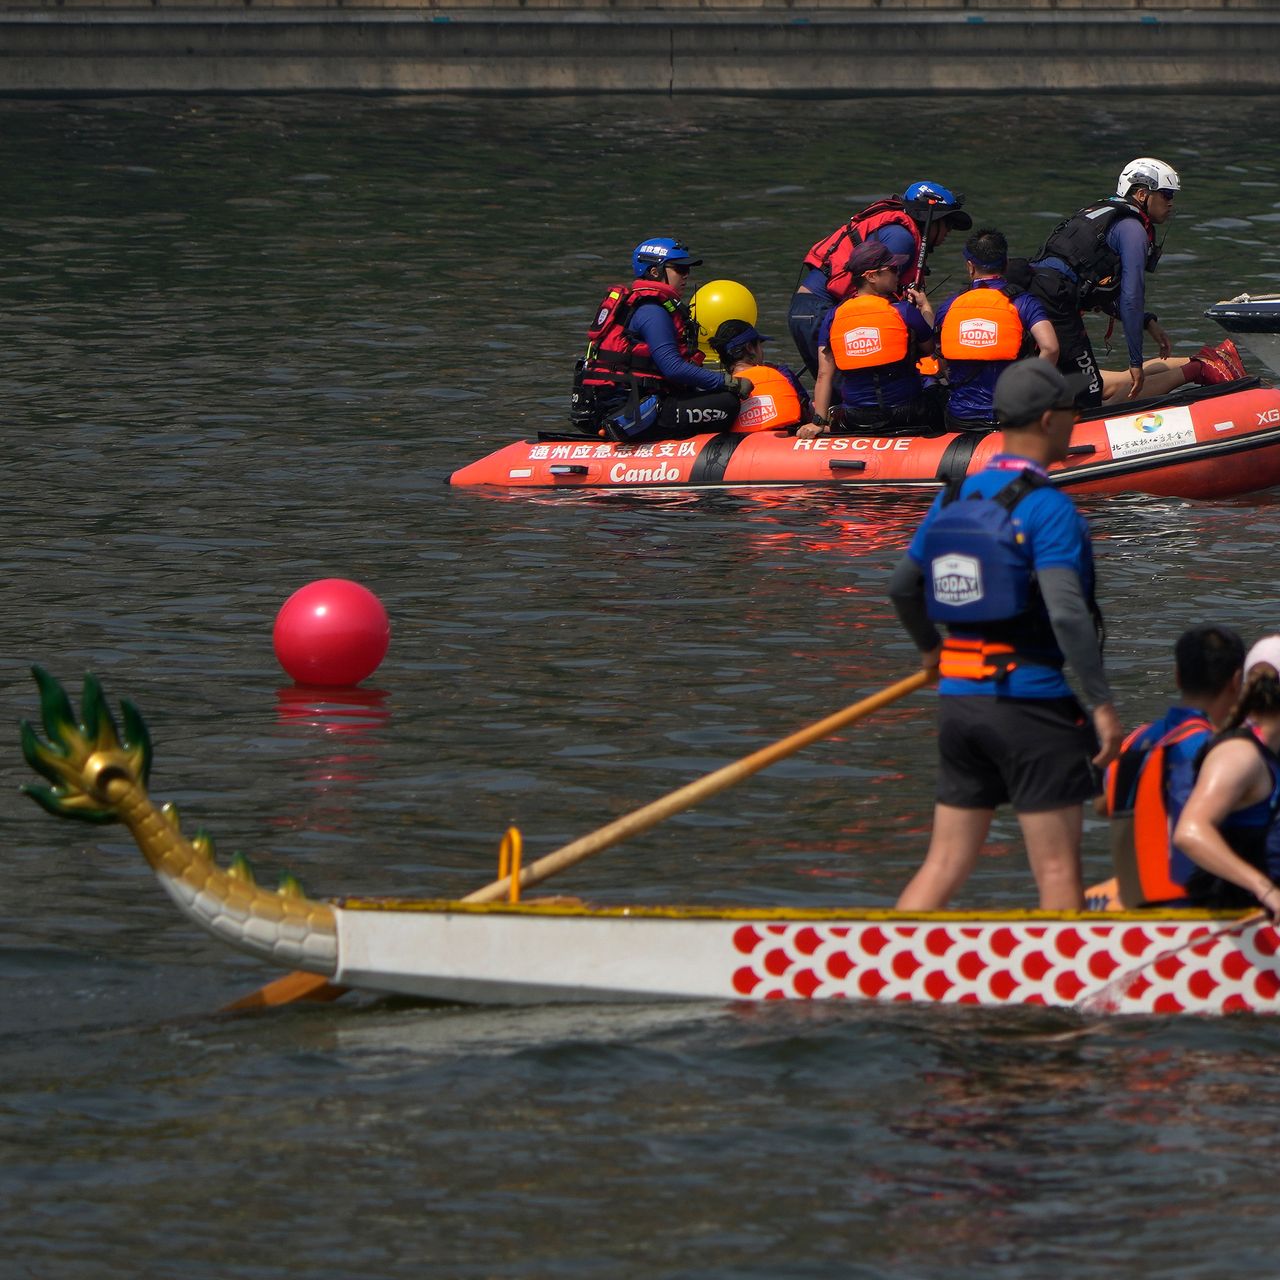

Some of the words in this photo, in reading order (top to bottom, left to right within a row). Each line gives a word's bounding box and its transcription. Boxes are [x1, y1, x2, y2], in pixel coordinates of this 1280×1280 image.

[961, 330, 995, 340] TODAY
[847, 338, 879, 350] TODAY
[741, 406, 773, 420] TODAY
[1257, 409, 1280, 425] XG
[528, 442, 696, 460] 通州应急志愿支队
[793, 438, 912, 451] RESCUE
[610, 462, 680, 482] Cando
